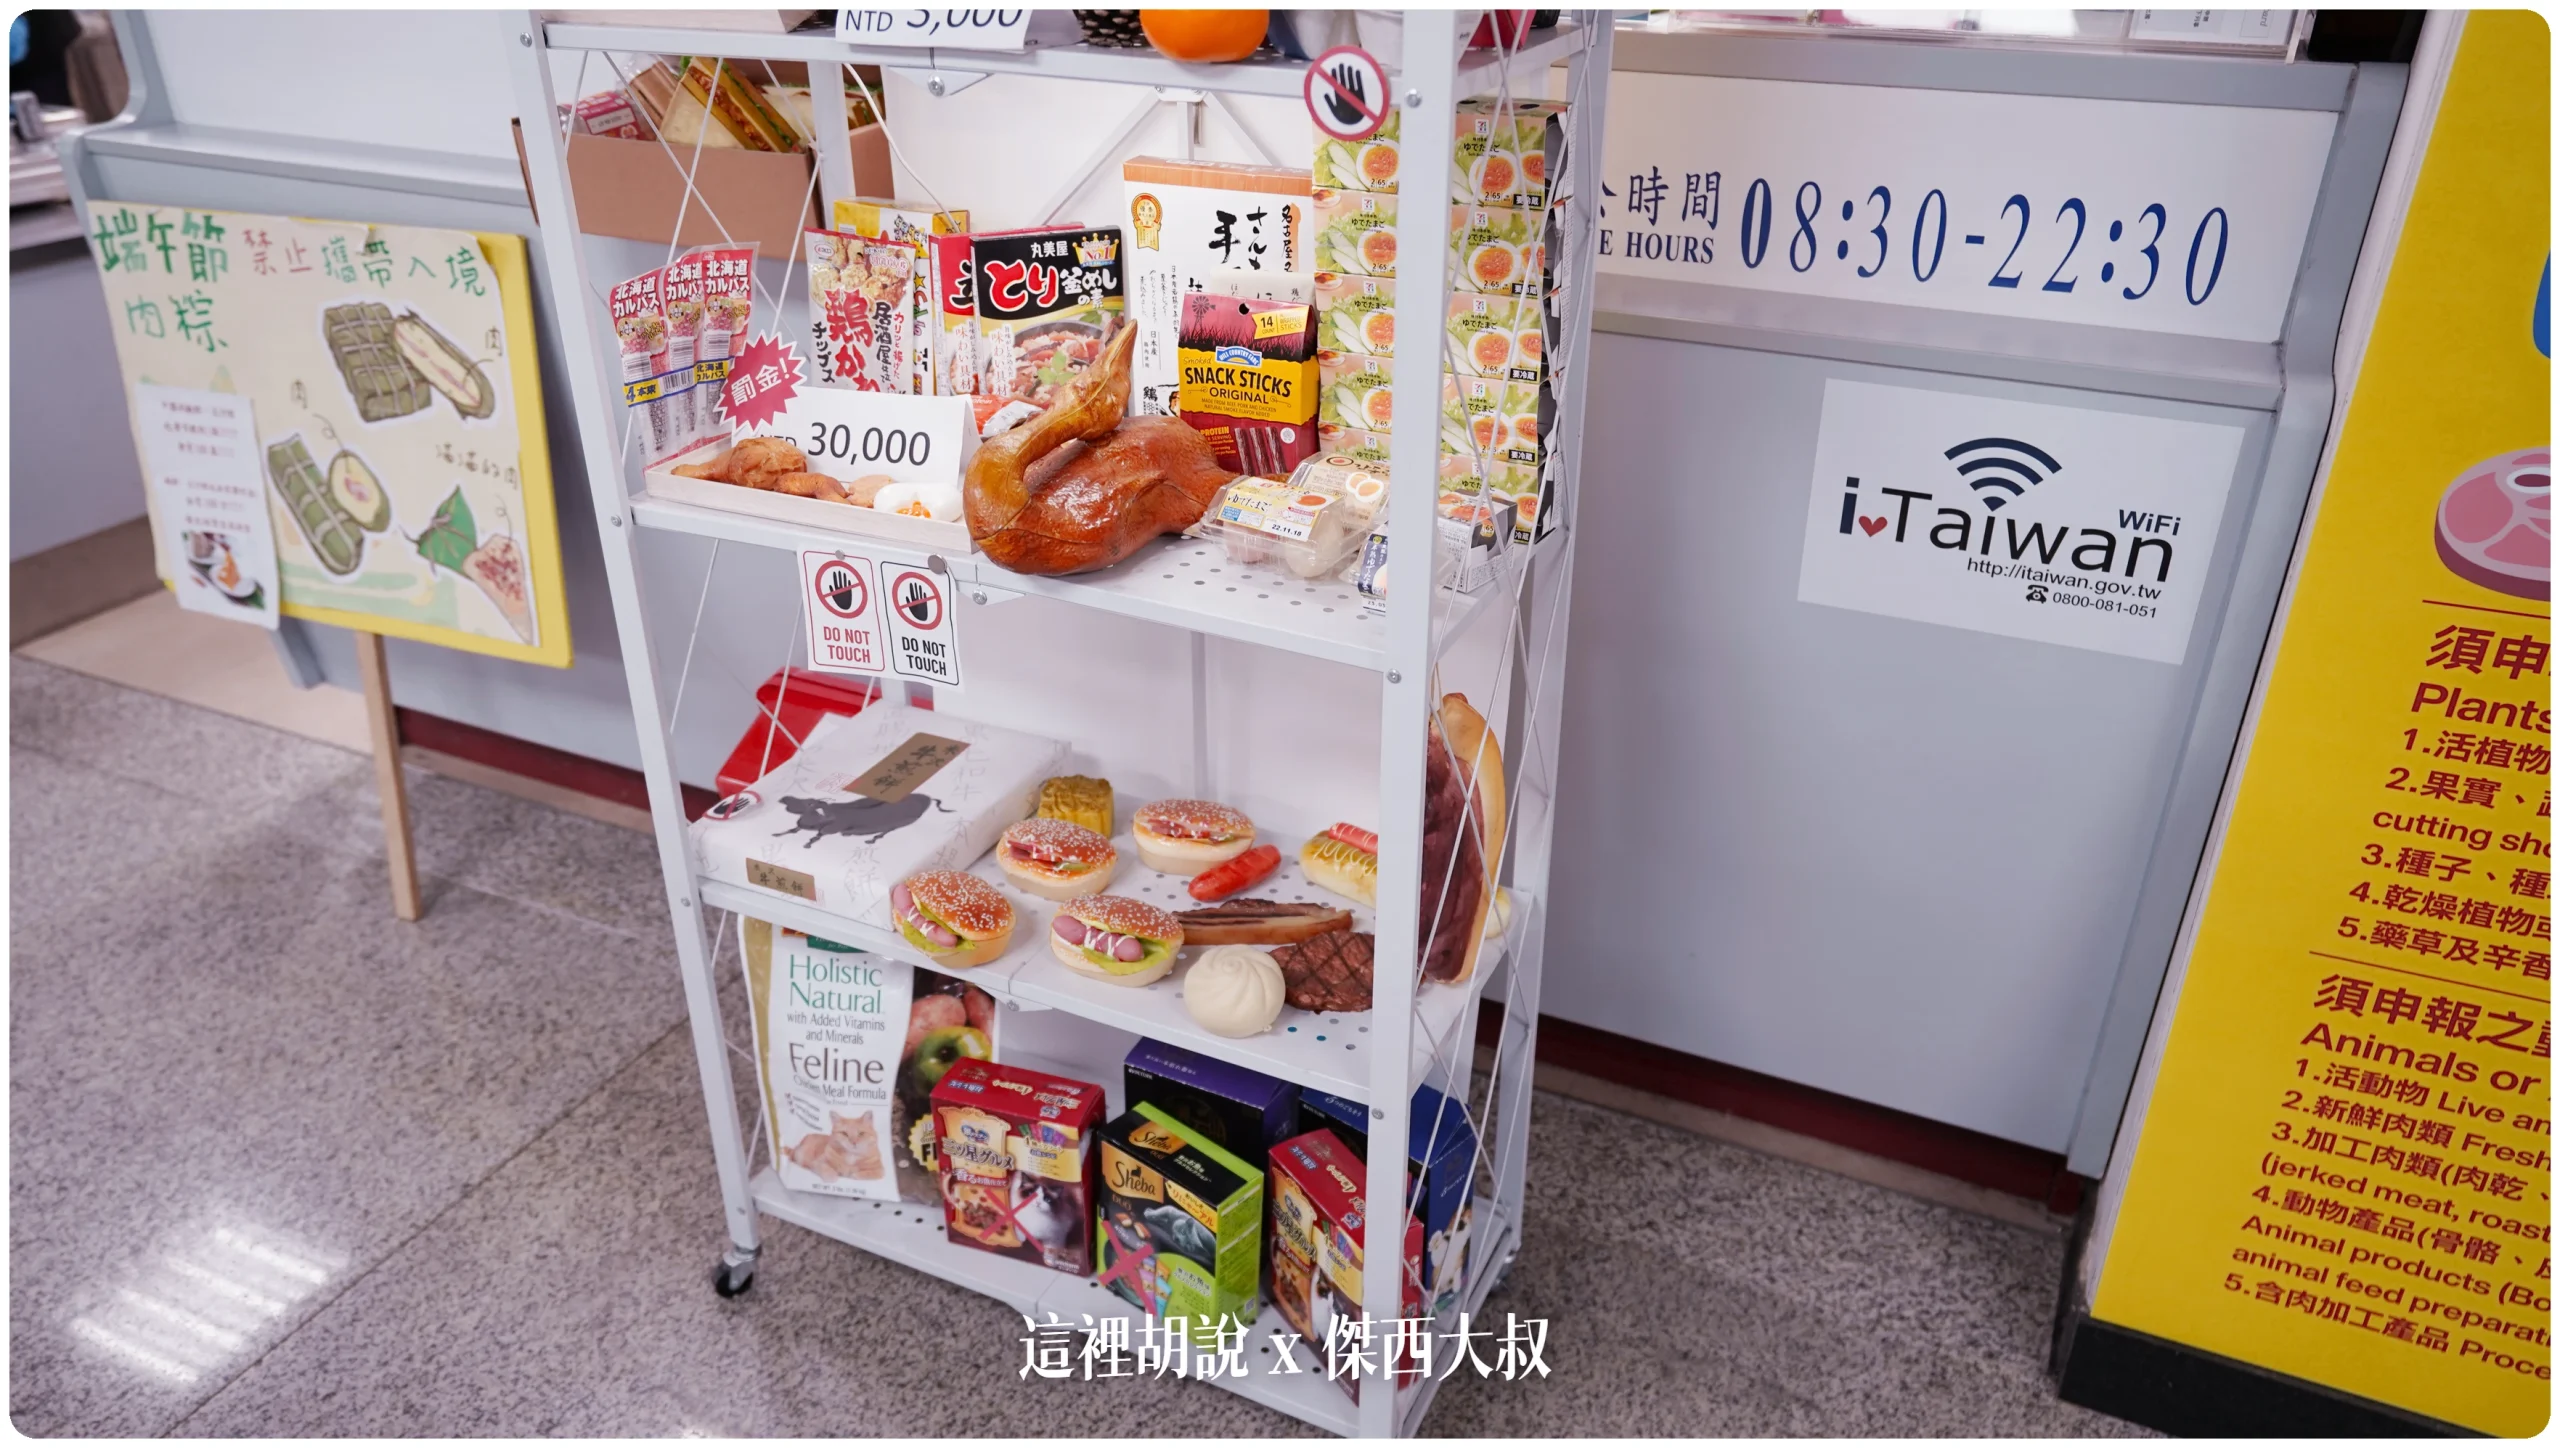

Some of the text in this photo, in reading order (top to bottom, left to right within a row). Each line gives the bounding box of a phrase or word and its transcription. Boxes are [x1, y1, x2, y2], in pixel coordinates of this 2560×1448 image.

[845, 10, 893, 32] NTD
[1351, 218, 1385, 229] ゆでたまご
[93, 208, 230, 284] 端午節
[1030, 240, 1069, 259] 丸美屋
[1624, 231, 1716, 265] HOURS
[1740, 177, 2230, 306] 08:30-22:30
[706, 258, 748, 278] 北海道
[614, 276, 656, 301] 北海道
[705, 277, 751, 295] カルパス
[1354, 300, 1388, 311] ゆでたまご
[123, 290, 230, 353] 肉粽
[1260, 315, 1274, 329] 14
[1461, 319, 1498, 330] ゆでたまご
[485, 326, 503, 356] 肉
[812, 321, 836, 384] チップス
[954, 326, 973, 390] 味わい具材
[1183, 356, 1213, 366] Smoked
[1185, 367, 1293, 398] SNACK STICKS
[1356, 376, 1389, 388] ゆでたまご
[1511, 369, 1536, 381] 要冷蔵
[290, 379, 309, 409] 肉
[1209, 386, 1270, 405] ORIGINAL
[807, 421, 931, 466] 30,000
[1200, 425, 1230, 436] PROTEIN
[1356, 451, 1388, 462] ゆでたまご
[1510, 449, 1534, 462] 要冷蔵
[1227, 493, 1273, 513] ゆでたまご
[2117, 508, 2181, 536] WiFi
[1966, 557, 2162, 600] http://itaiwan.gov.tw
[2052, 591, 2158, 619] 0800-081-051
[823, 626, 871, 646] DO NOT
[901, 636, 947, 659] DO NOT
[827, 644, 871, 664] TOUCH
[906, 654, 947, 677] TOUCH
[2403, 728, 2551, 775] 1.活植物
[2372, 810, 2493, 852] cutting
[789, 953, 883, 988] Holistic
[790, 981, 882, 1015] Natural
[787, 1012, 886, 1032] with Added Vitamins
[805, 1030, 864, 1046] and Minerals
[789, 1042, 885, 1085] Feline
[2300, 1021, 2542, 1096] Animals or
[822, 1084, 845, 1099] Meal
[848, 1085, 887, 1100] Formula
[2295, 1057, 2430, 1108] 1.活動物
[2436, 1090, 2505, 1124] Live
[1134, 1131, 1172, 1152] Sheba
[2281, 1089, 2551, 1173] 2.新鮮肉類 Fresh
[942, 1136, 1015, 1170] 三ツ星グルメ
[1112, 1160, 1156, 1196] Sheba
[2260, 1151, 2367, 1196] (jerked
[2372, 1182, 2461, 1223] meat,
[2231, 1247, 2328, 1285] animal
[2335, 1271, 2406, 1305] feed
[2241, 1214, 2551, 1312] Animal products (Bo
[2223, 1272, 2551, 1381] 5.含肉加工產品 Proce
